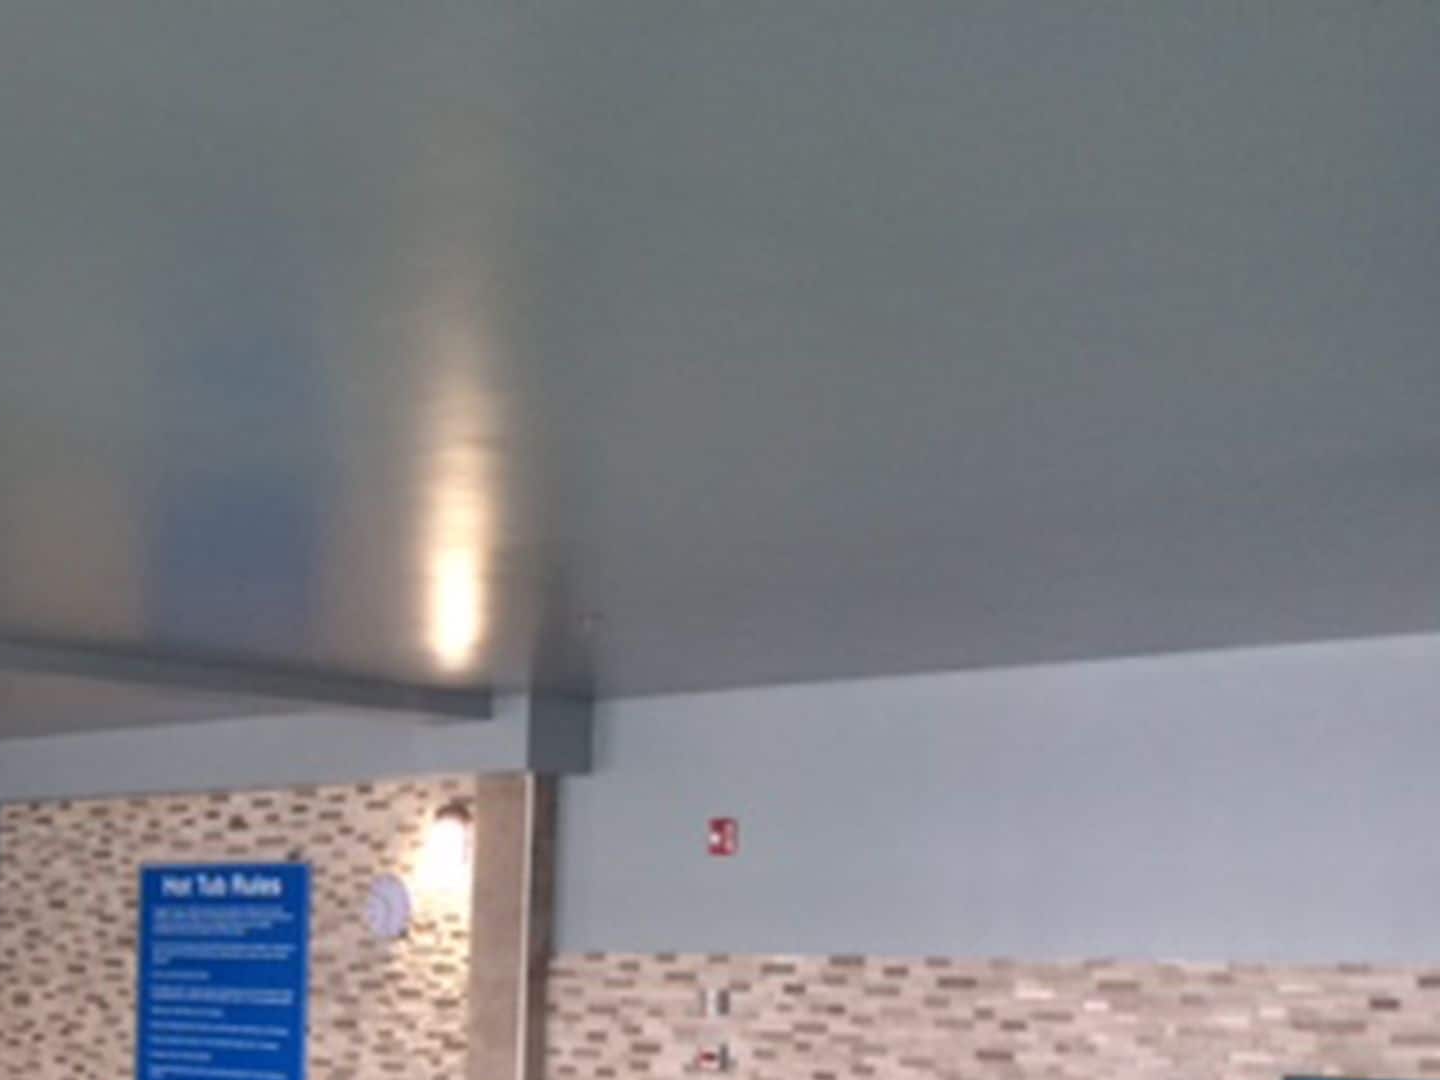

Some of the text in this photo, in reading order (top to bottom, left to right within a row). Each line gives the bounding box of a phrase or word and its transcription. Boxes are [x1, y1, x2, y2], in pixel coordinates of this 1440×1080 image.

[162, 873, 282, 897] Hot Tub Rules
